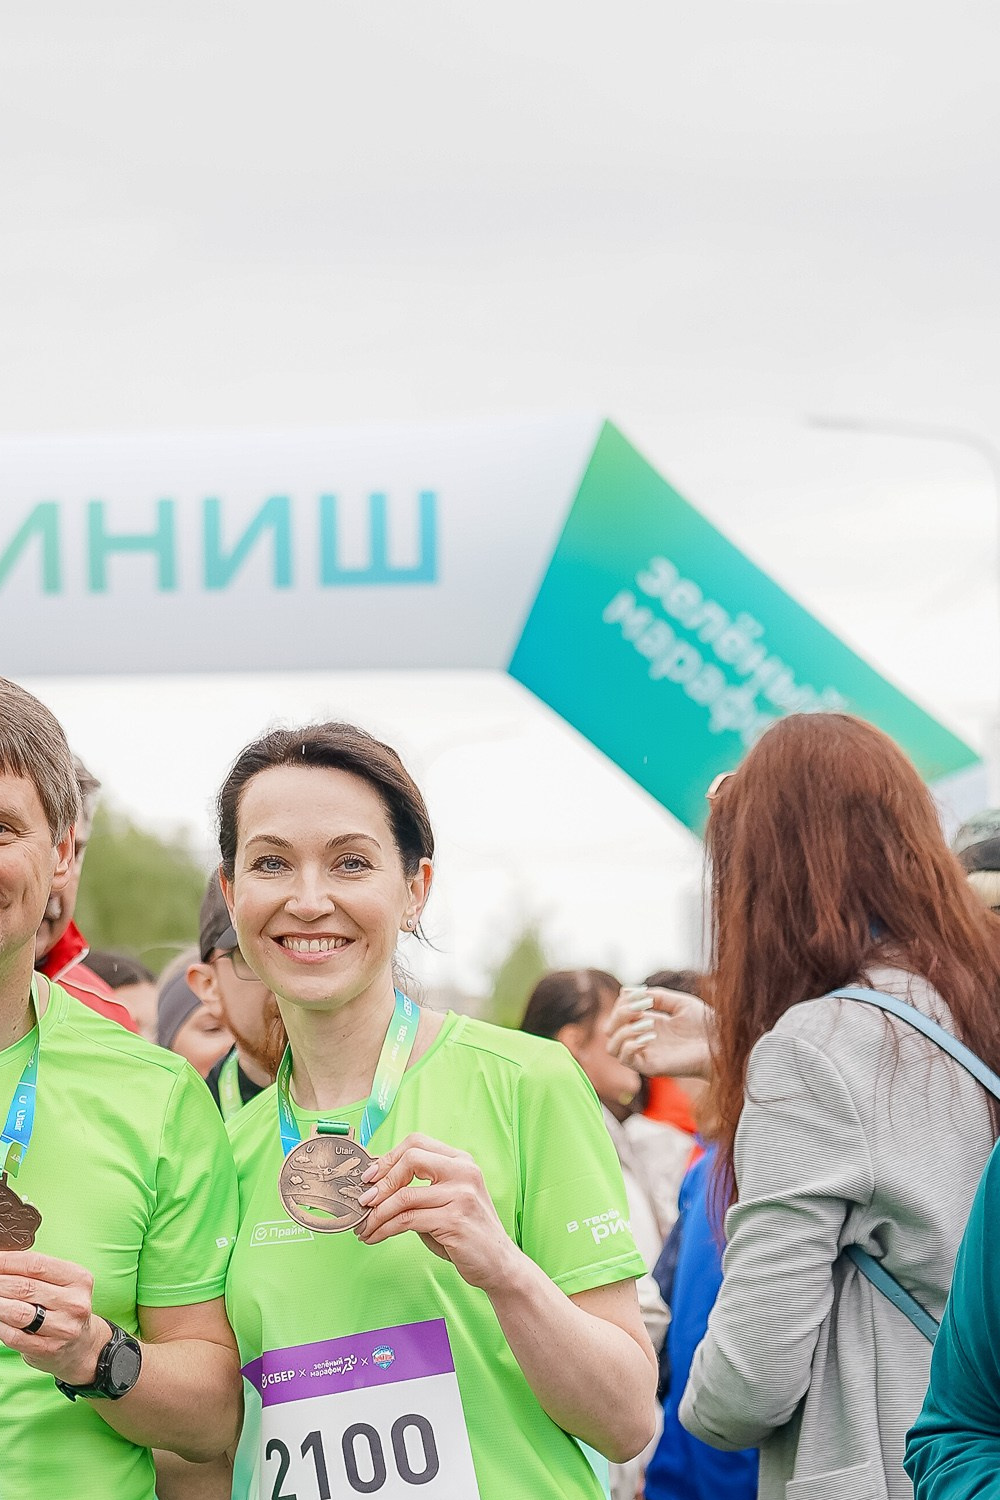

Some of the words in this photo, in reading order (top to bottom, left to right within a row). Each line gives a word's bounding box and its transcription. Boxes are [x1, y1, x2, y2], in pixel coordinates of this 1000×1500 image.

[602, 589, 778, 742] мараф
[13, 1109, 26, 1132] Utair
[335, 1146, 355, 1156] Utair
[269, 1225, 306, 1239] Прайм
[566, 1220, 580, 1234] В
[313, 1356, 344, 1370] зелёный
[267, 1369, 296, 1384] СБЕР
[310, 1366, 342, 1379] марафон
